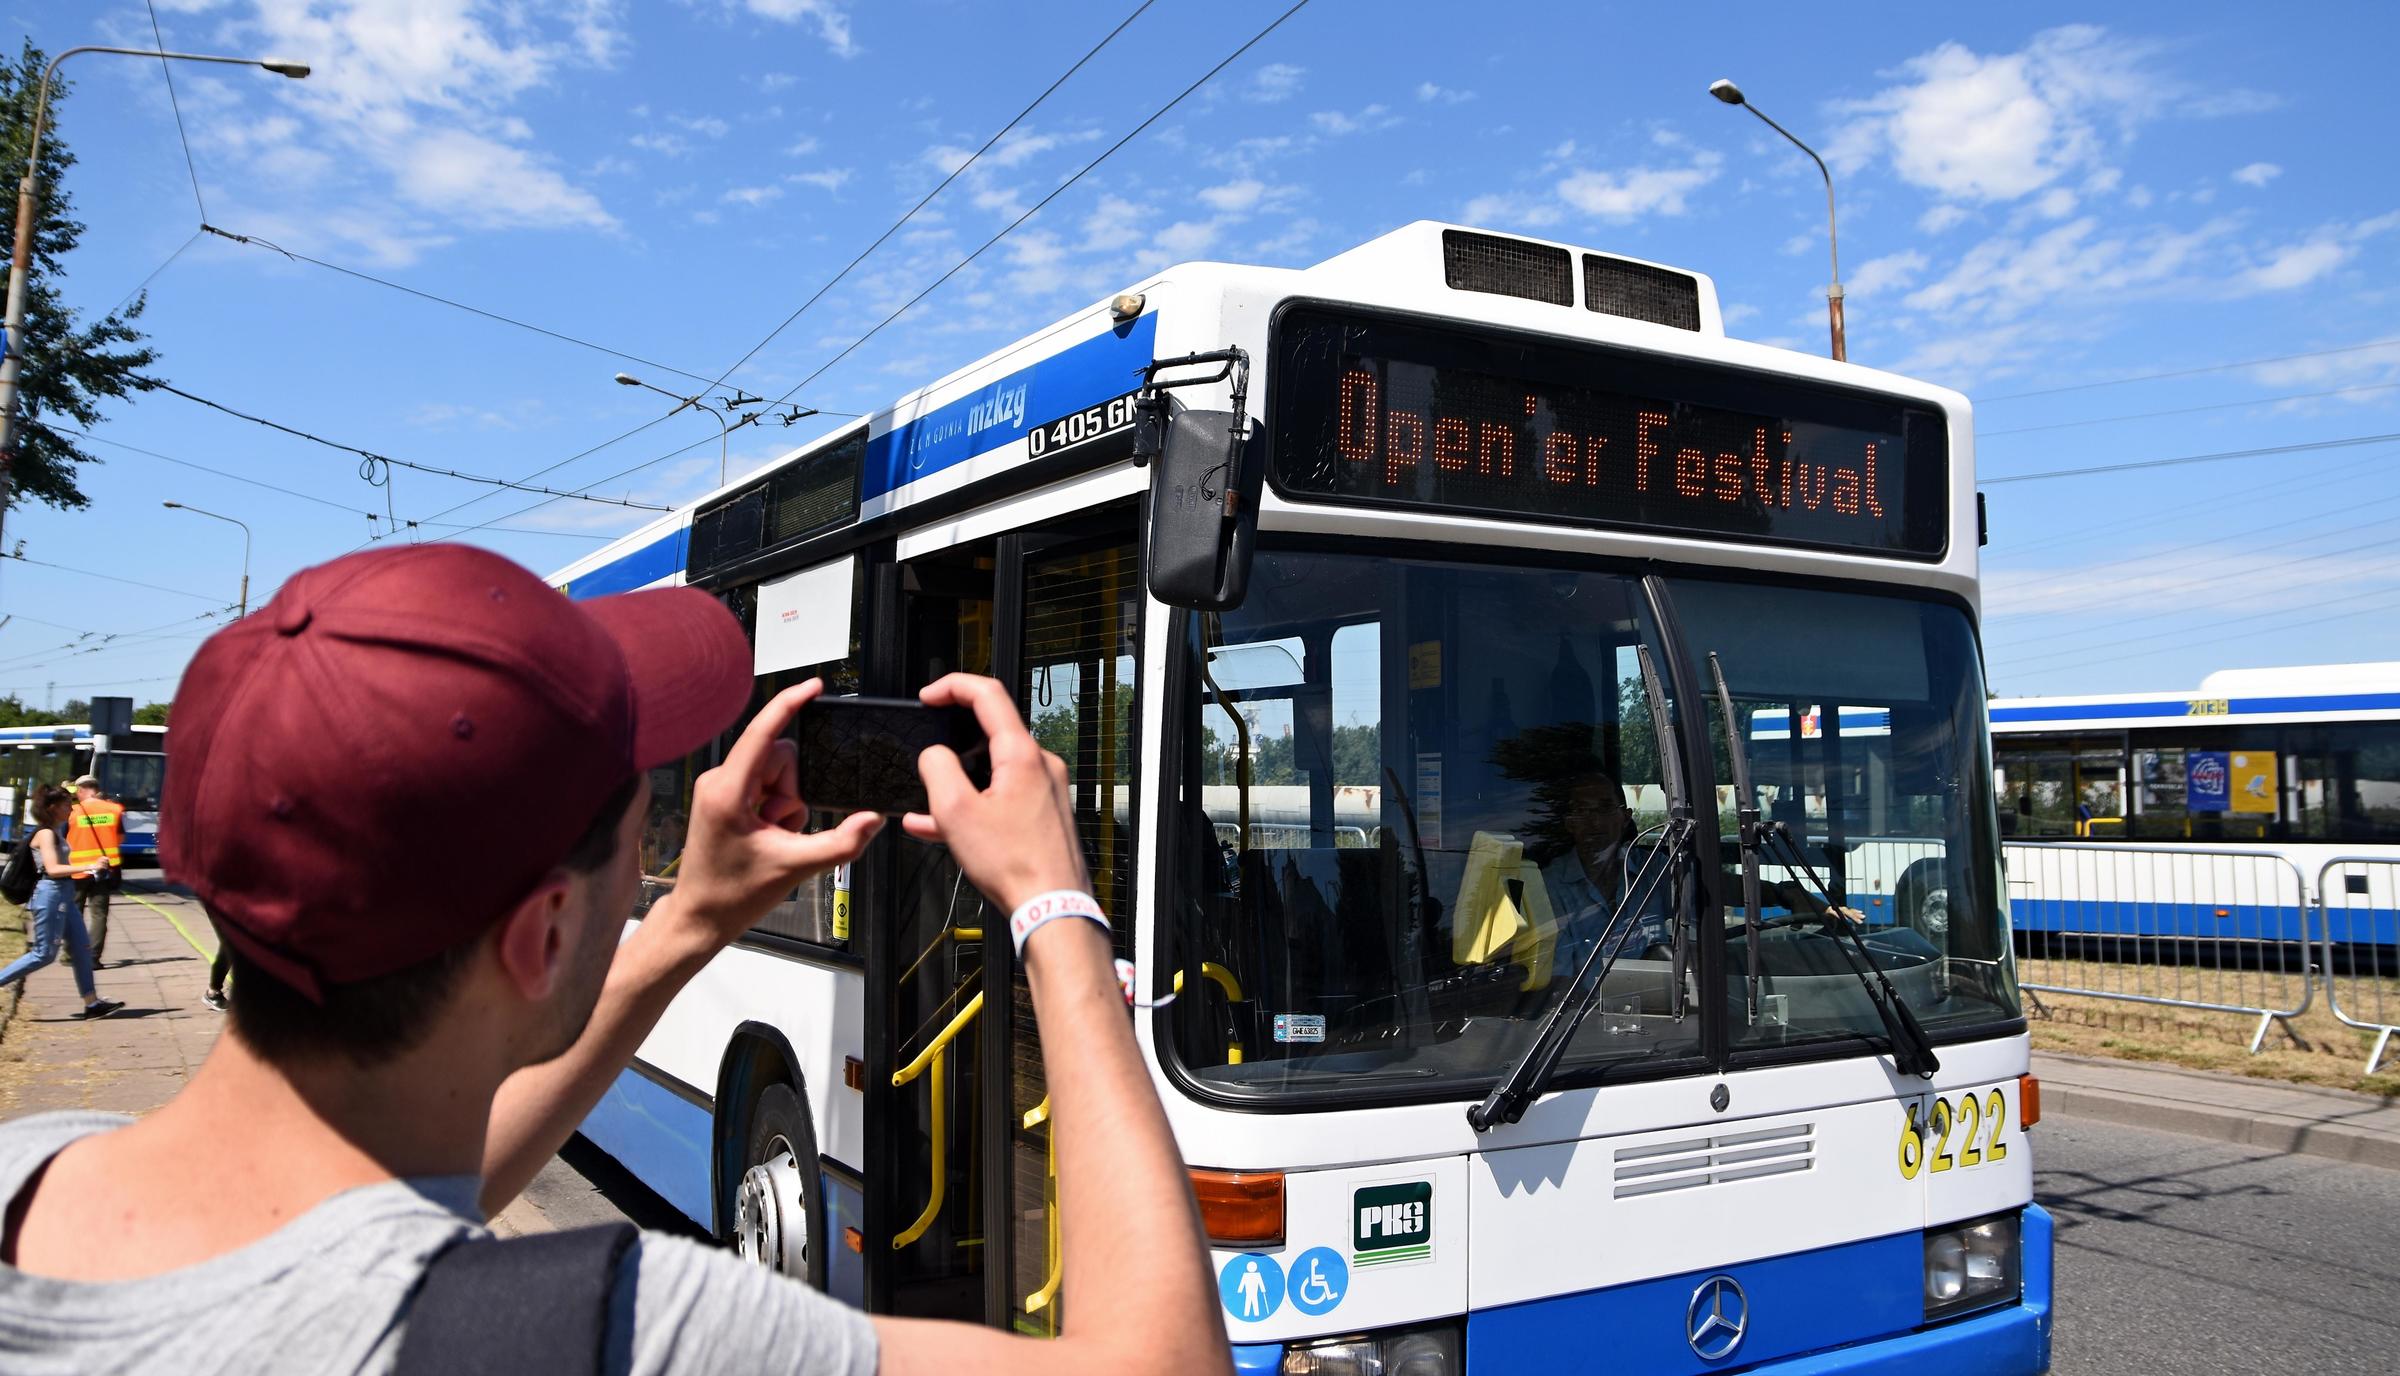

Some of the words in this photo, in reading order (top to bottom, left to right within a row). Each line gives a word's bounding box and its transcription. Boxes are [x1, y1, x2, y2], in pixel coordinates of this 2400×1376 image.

[933, 418, 962, 444] GDYNIA
[967, 383, 1026, 437] mzkzg
[1050, 407, 1102, 446] 405
[1339, 371, 1608, 485] Open'er
[1637, 411, 1883, 518] Festival
[1898, 1087, 2007, 1180] 6222
[1360, 1201, 1424, 1239] PKS
